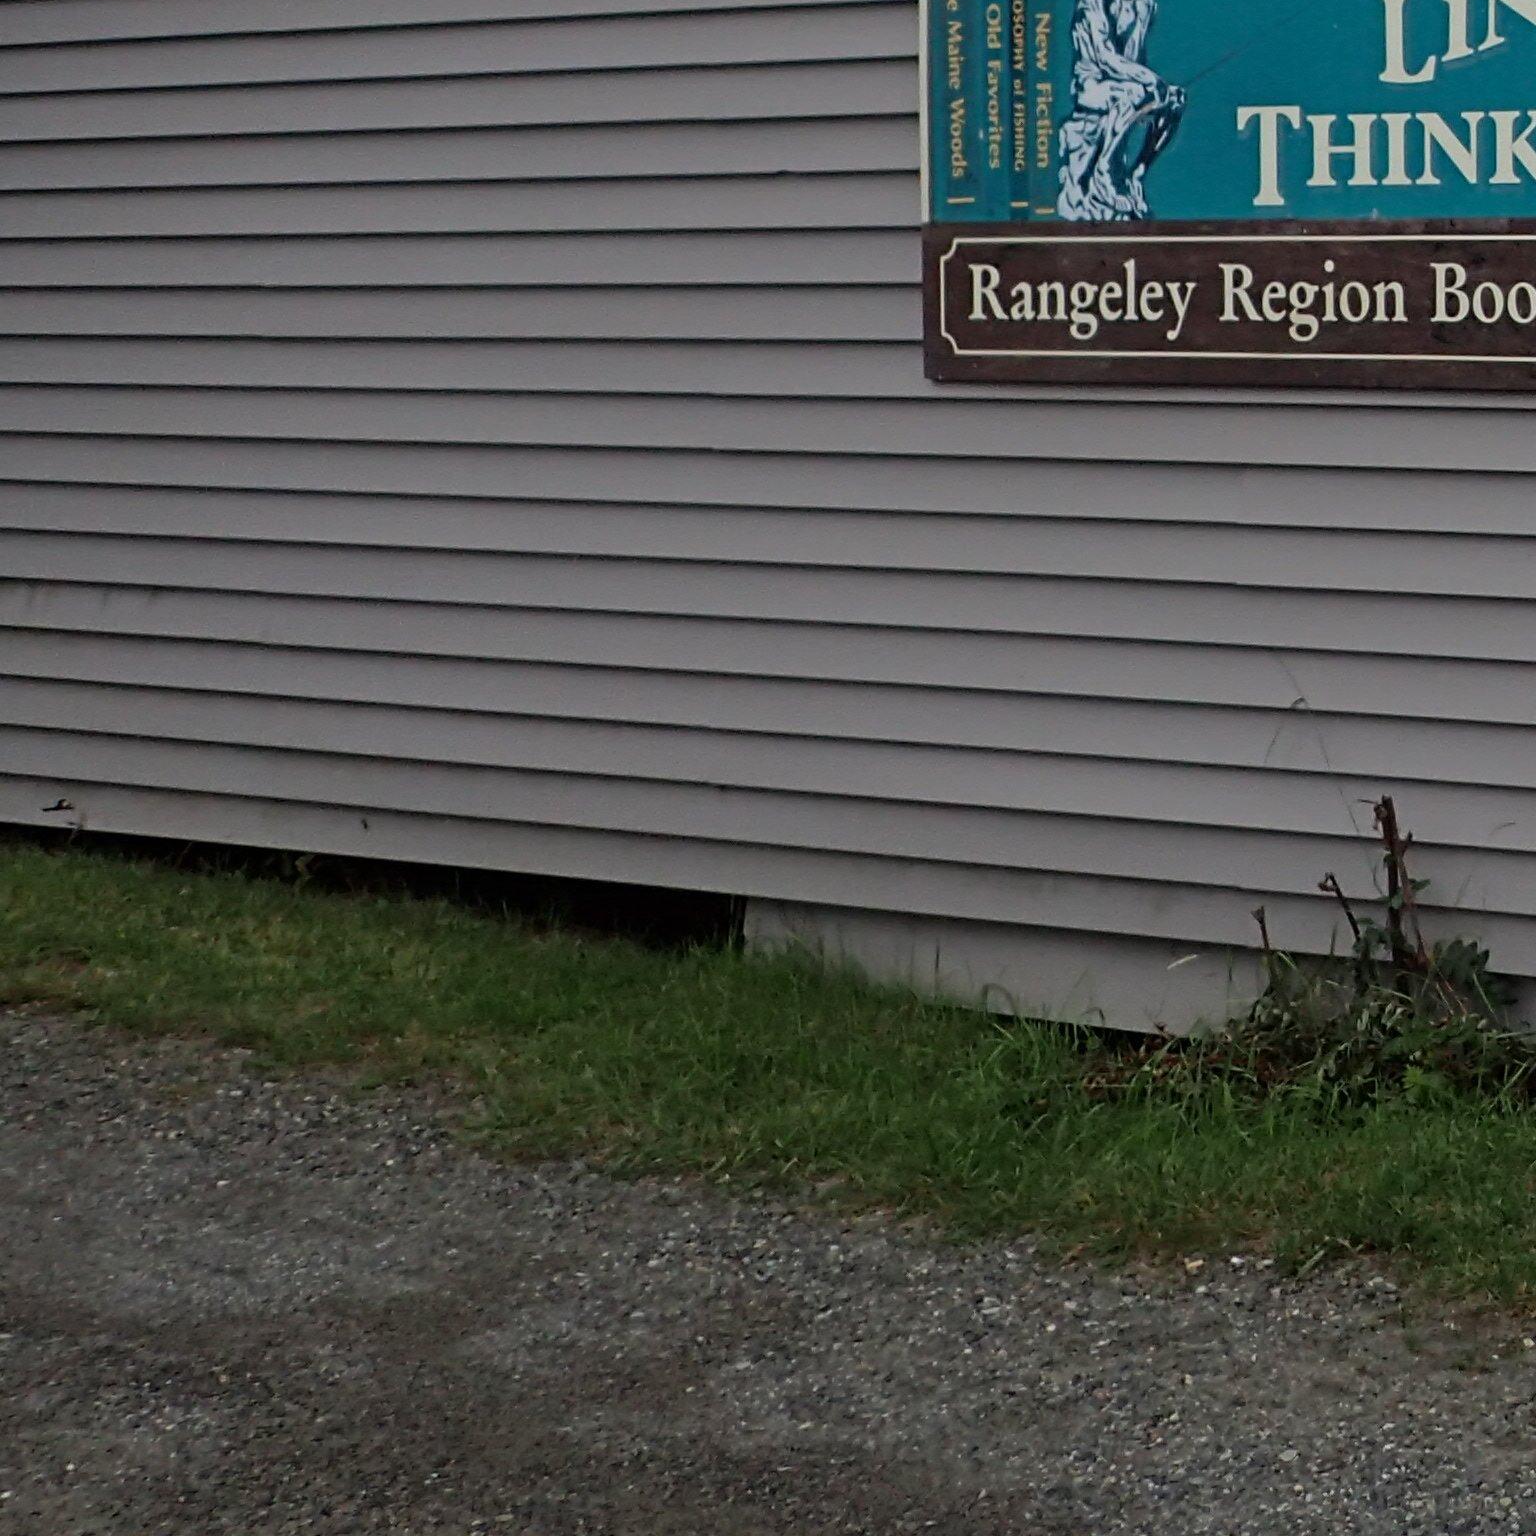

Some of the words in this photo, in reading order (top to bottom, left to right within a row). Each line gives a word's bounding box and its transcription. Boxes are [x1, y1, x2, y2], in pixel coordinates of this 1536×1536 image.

[947, 21, 967, 89] Maine
[986, 3, 1002, 49] Old
[1034, 12, 1052, 71] New
[948, 98, 968, 177] Woods
[986, 61, 1004, 169] Favorites
[1035, 83, 1053, 168] Fiction
[968, 259, 1195, 341] Rangeley
[1219, 259, 1408, 343] Region
